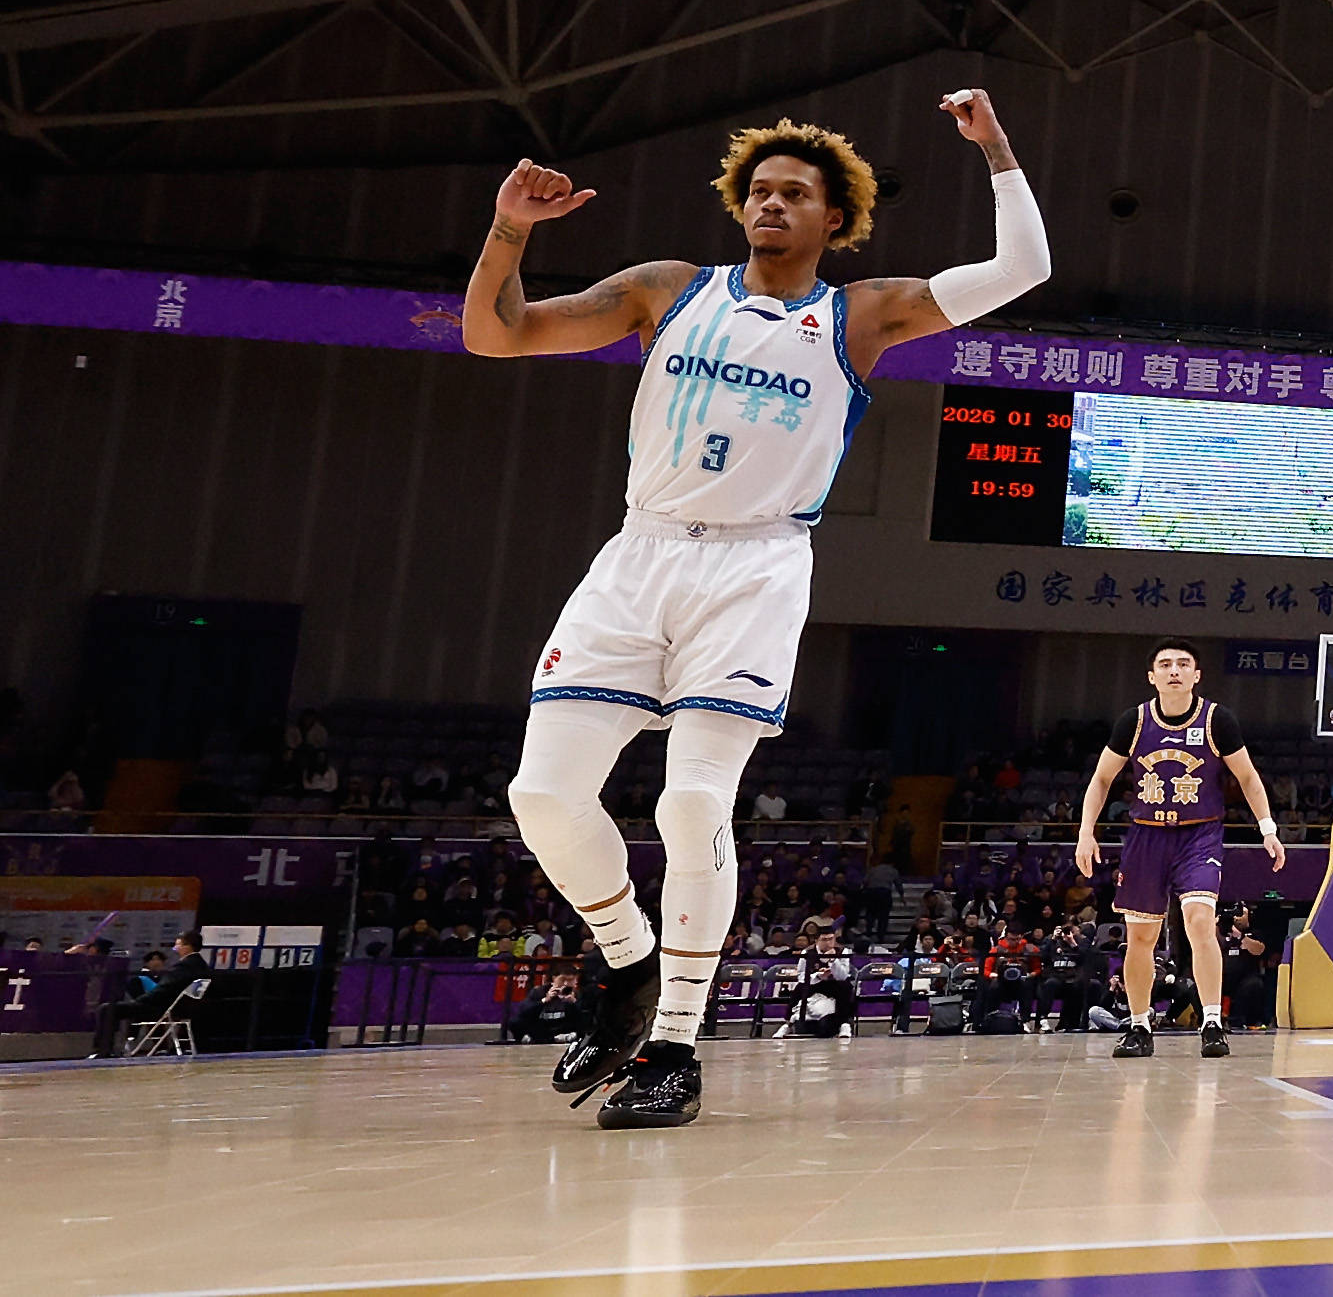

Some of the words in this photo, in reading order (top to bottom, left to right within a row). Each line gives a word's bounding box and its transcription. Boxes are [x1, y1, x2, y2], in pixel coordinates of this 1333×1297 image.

[154, 280, 188, 329] 北京
[800, 336, 817, 344] CGB
[666, 354, 811, 399] QINGDAO
[951, 339, 1124, 388] 遵守规则
[1140, 353, 1304, 399] 尊重对手
[943, 406, 996, 425] 2026
[1008, 410, 1031, 427] 01
[1046, 412, 1072, 429] 30
[701, 433, 731, 472] 3
[966, 442, 1043, 465] 星期五
[970, 479, 1035, 498] 19:59
[1137, 772, 1204, 805] 北京
[216, 948, 249, 965] 18
[279, 948, 315, 966] 17
